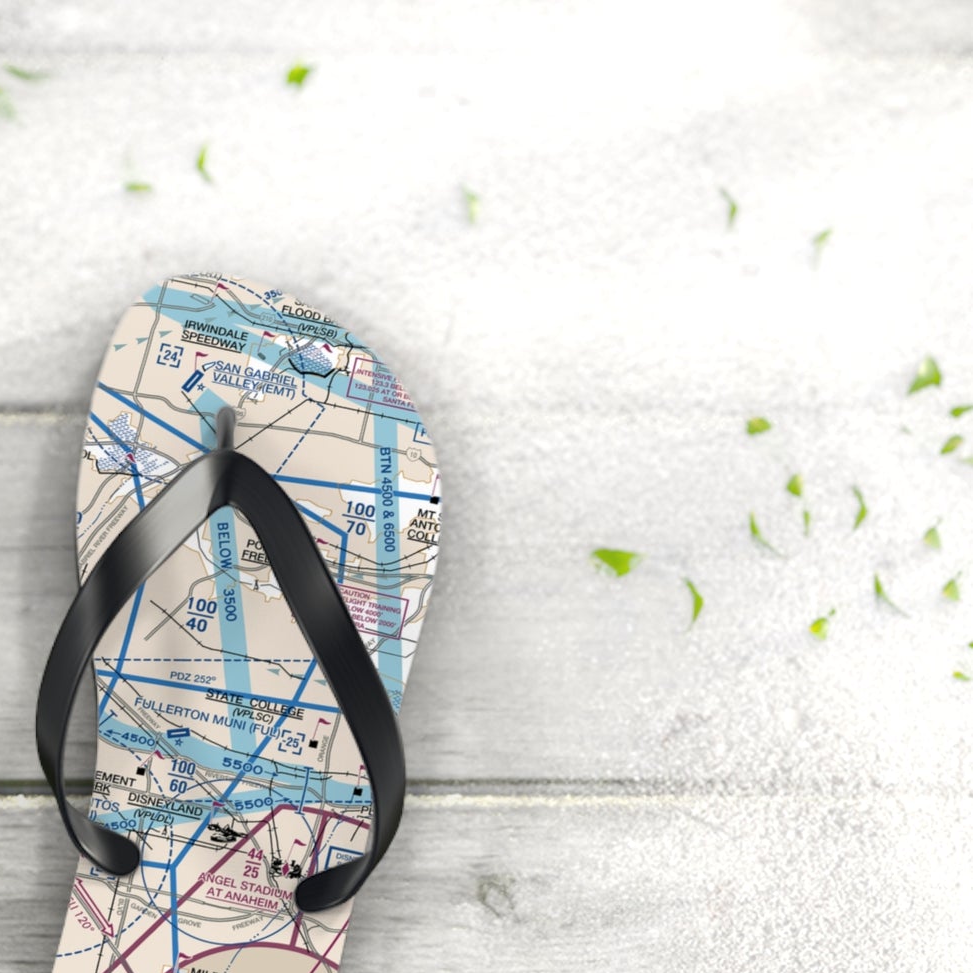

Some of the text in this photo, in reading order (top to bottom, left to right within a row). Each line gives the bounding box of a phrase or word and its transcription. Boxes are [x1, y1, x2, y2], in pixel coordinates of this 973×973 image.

[282, 305, 321, 320] FLOOD
[185, 320, 248, 340] IRWINDALE
[298, 323, 337, 339] (VPLSB)
[182, 330, 246, 351] SPEEDWAY
[163, 349, 177, 362] 24
[215, 361, 297, 386] SAN GABRIEL
[213, 372, 296, 400] VALLEY (EMT)
[383, 396, 406, 406] SANTA
[380, 447, 395, 552] BTN 4500 & 6500
[347, 501, 375, 517] 100
[418, 509, 434, 519] MT
[347, 521, 366, 535] 70
[217, 523, 237, 621] BELOW 3500
[188, 597, 217, 614] 100
[369, 603, 401, 614] TRAINING
[186, 618, 207, 632] 40
[170, 671, 191, 681] PDZ
[207, 689, 305, 717] STATE COLLEGE
[134, 697, 280, 739] FULLERTON MUNI (FUL)
[233, 708, 273, 724] (VPLSC)
[121, 733, 155, 746] 4500
[171, 759, 196, 775] 100
[223, 758, 263, 774] 5500
[95, 771, 136, 787] EMENT
[170, 780, 187, 793] 60
[128, 792, 203, 816] DISNEYLAND
[235, 797, 273, 811] 5500
[248, 848, 263, 861] 44
[243, 866, 259, 878] 25
[198, 872, 293, 899] ANGEL STADIUM
[207, 887, 278, 910] AT ANAHEIM
[131, 903, 263, 931] GARDEN GROVE FREEWAY
